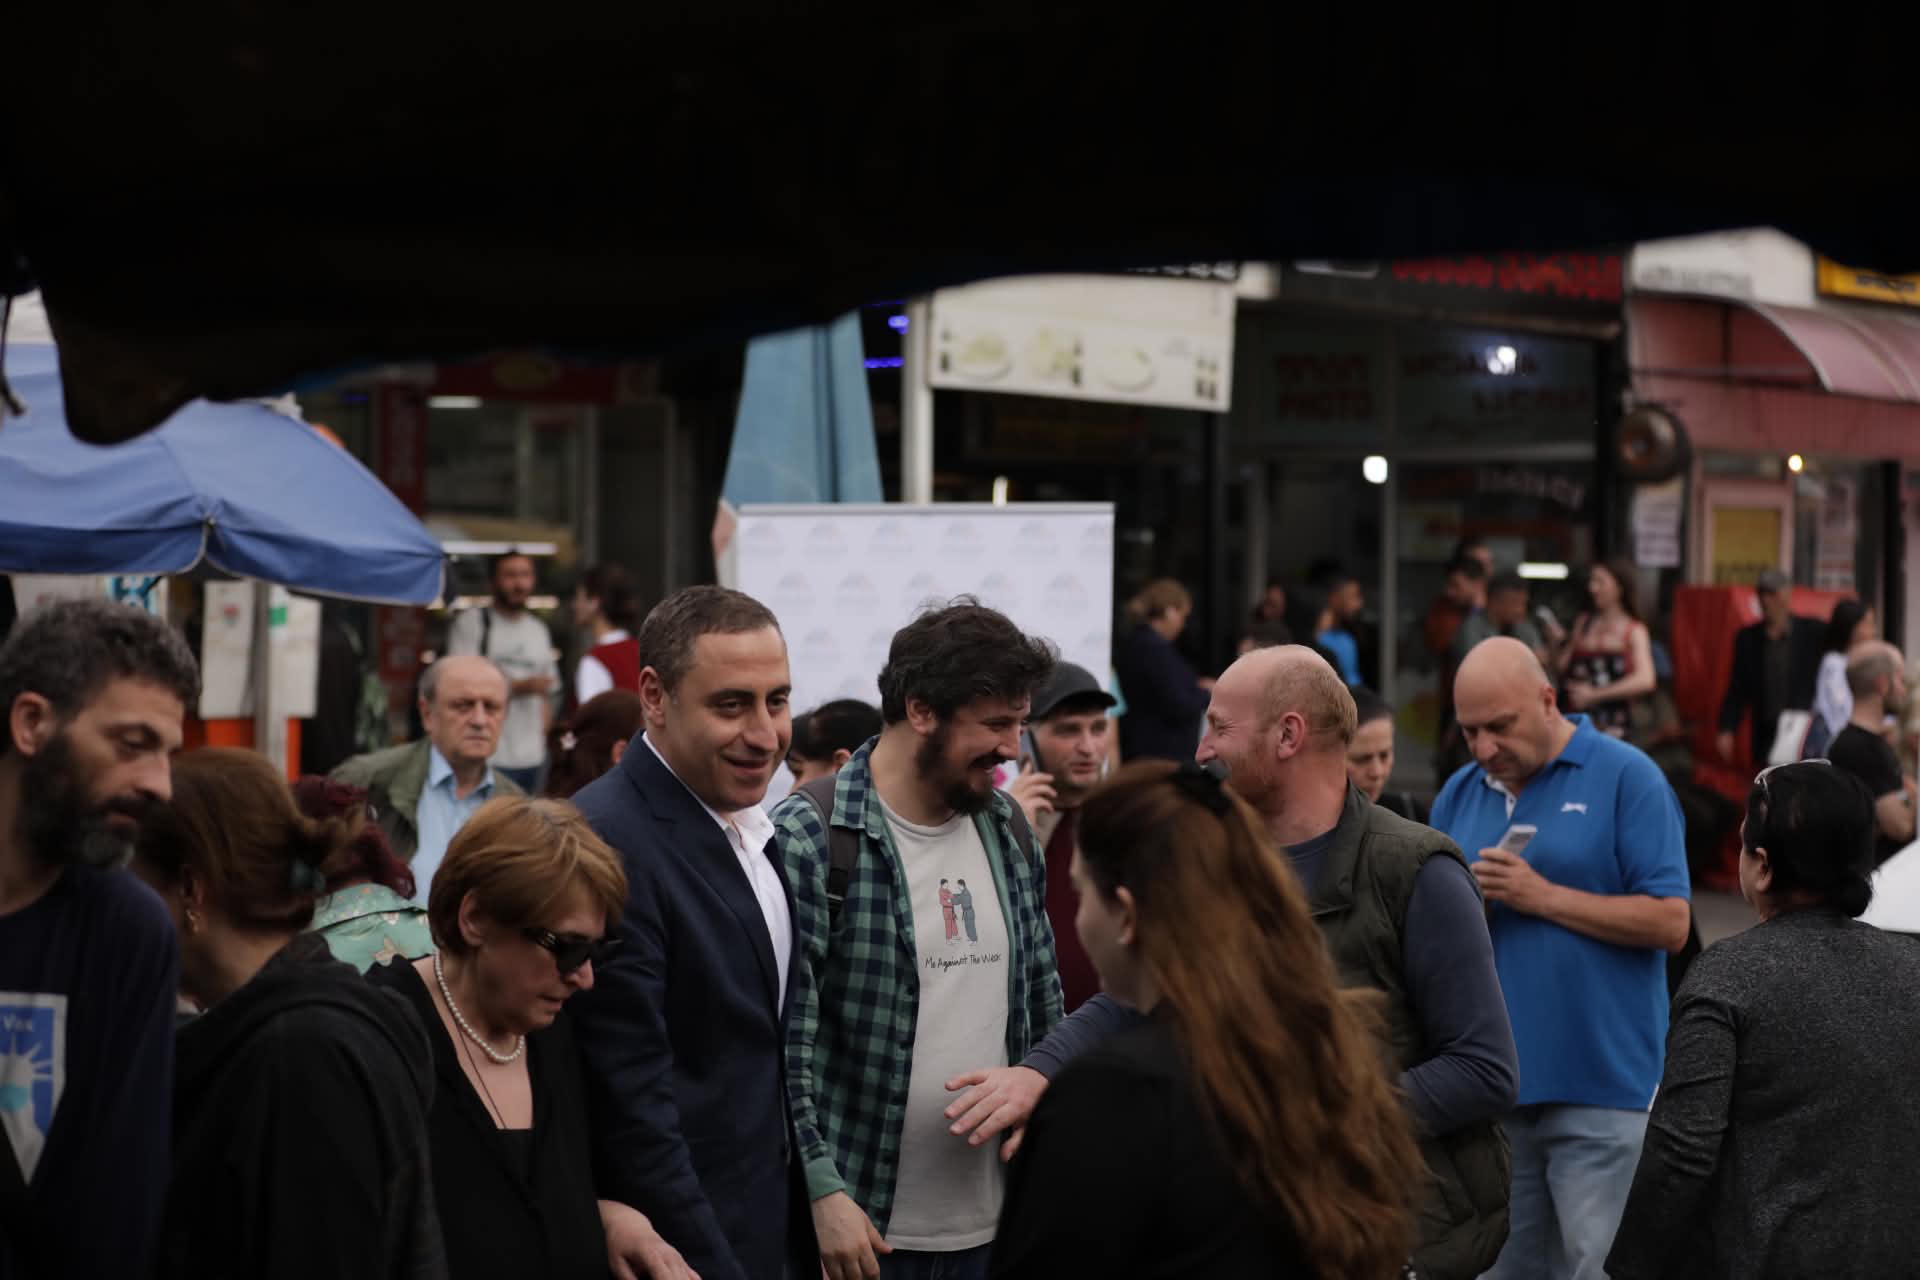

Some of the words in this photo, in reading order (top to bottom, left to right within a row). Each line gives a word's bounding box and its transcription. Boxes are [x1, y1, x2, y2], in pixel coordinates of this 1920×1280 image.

[925, 956, 936, 968] Me
[937, 955, 968, 972] Against
[970, 954, 981, 966] The
